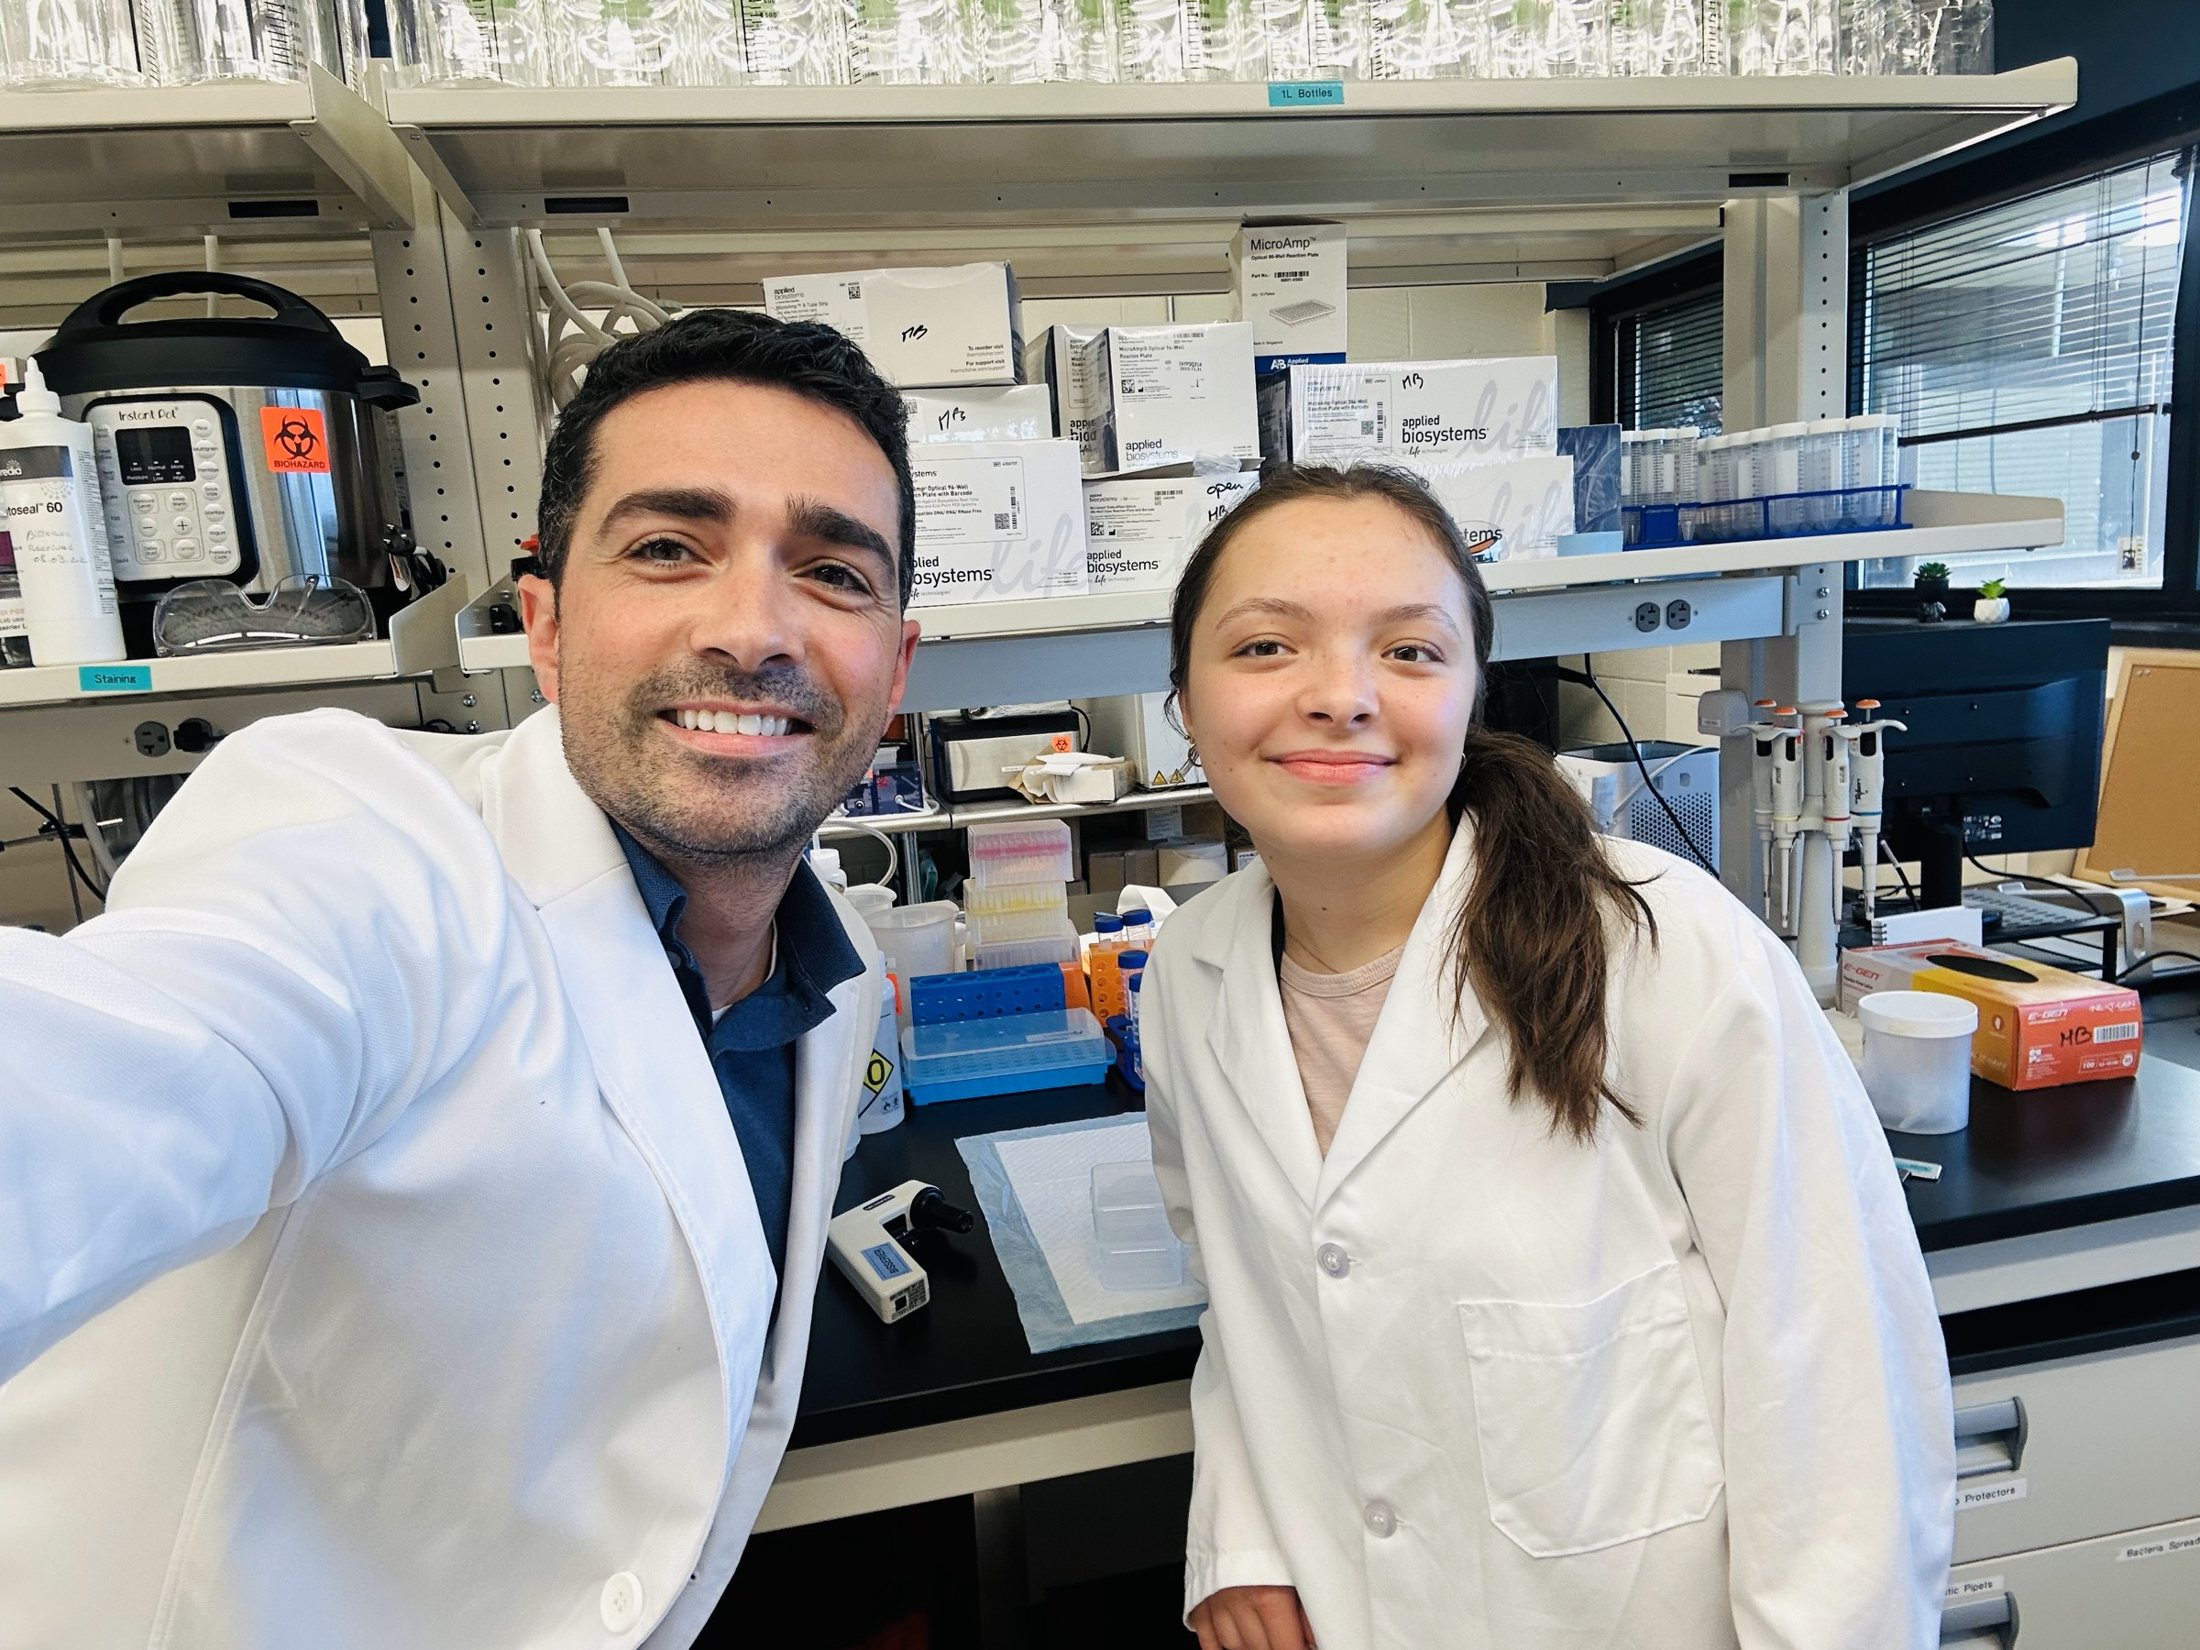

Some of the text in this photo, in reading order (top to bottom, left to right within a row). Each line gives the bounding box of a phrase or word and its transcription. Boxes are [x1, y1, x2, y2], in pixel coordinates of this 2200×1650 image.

[1281, 88, 1333, 99] 1L Bottles
[774, 286, 795, 295] applied
[118, 409, 154, 421] Instant
[1402, 415, 1440, 429] applied
[1402, 427, 1488, 446] biosystems
[1125, 439, 1162, 452] applied
[1126, 449, 1179, 462] biosystems
[274, 460, 326, 469] BIOHAZARD
[46, 501, 63, 513] 60
[1086, 549, 1122, 562] applied
[1087, 560, 1159, 575] biosystems
[95, 673, 137, 685] Staining
[1843, 962, 1880, 981] E-GEN
[1965, 1486, 2016, 1504] Protectors
[2126, 1543, 2164, 1558] Bacteria
[1964, 1581, 1993, 1595] Pipets
